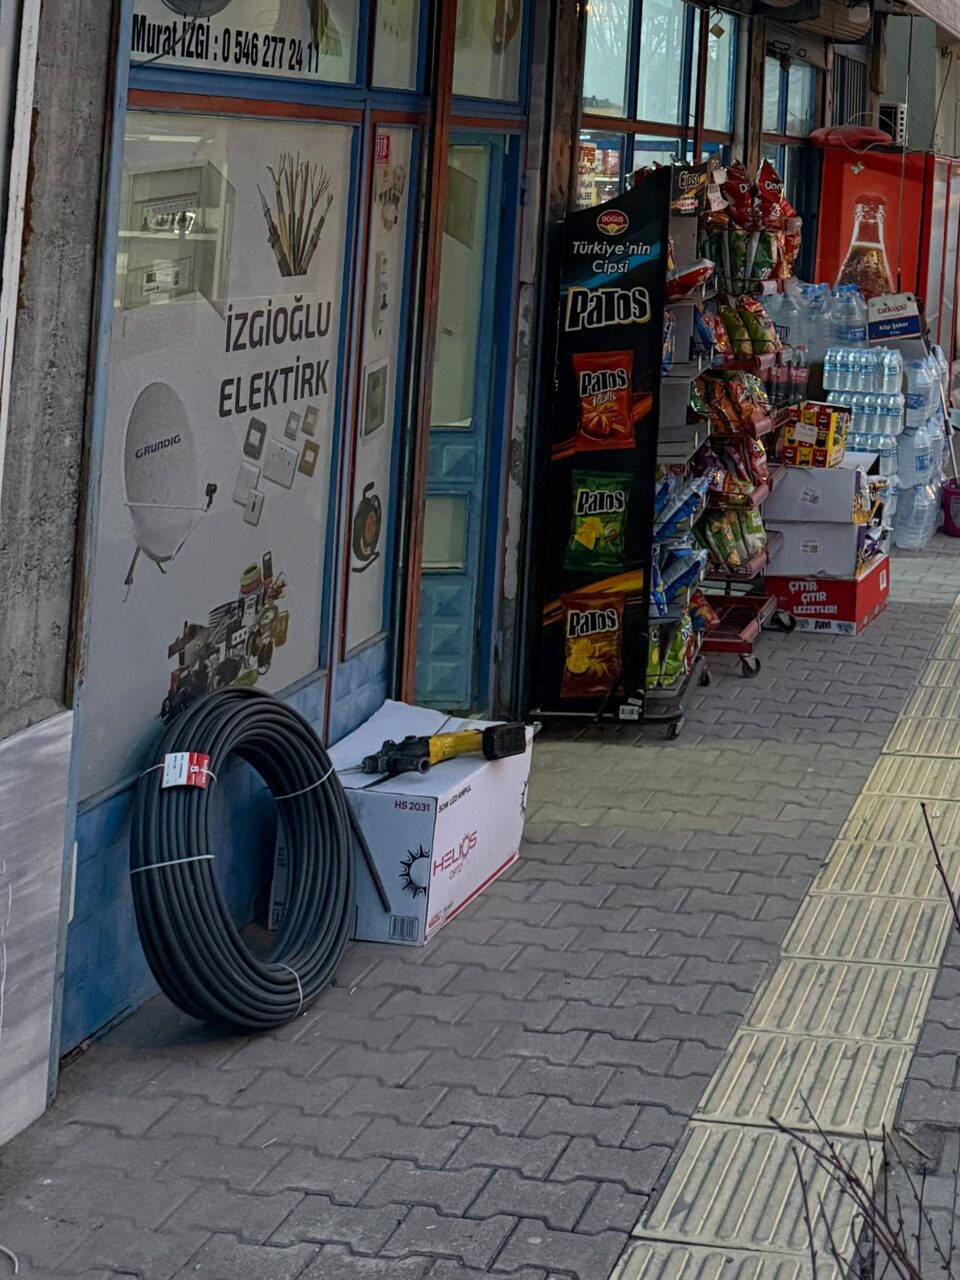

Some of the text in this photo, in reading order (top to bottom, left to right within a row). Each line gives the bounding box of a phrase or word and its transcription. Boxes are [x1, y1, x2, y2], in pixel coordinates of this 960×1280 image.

[131, 14, 178, 57] Murat
[180, 12, 211, 61] İZGİ
[222, 28, 231, 63] 0
[234, 30, 259, 67] 546
[262, 34, 287, 70] 277
[288, 38, 303, 72] 24
[307, 41, 321, 74] 11
[572, 241, 652, 258] Türkiye'nin
[592, 260, 630, 276] Cipsi
[225, 295, 332, 353] İZGİOĞLU
[218, 355, 330, 418] ELEKTİRK
[135, 434, 181, 459] GRUNDIG
[788, 581, 818, 594] ÇITIR
[801, 592, 827, 605] ÇITIR
[793, 604, 838, 615] LEZZETLER!
[394, 800, 431, 812] HS 2031
[433, 830, 478, 876] HELIOS
